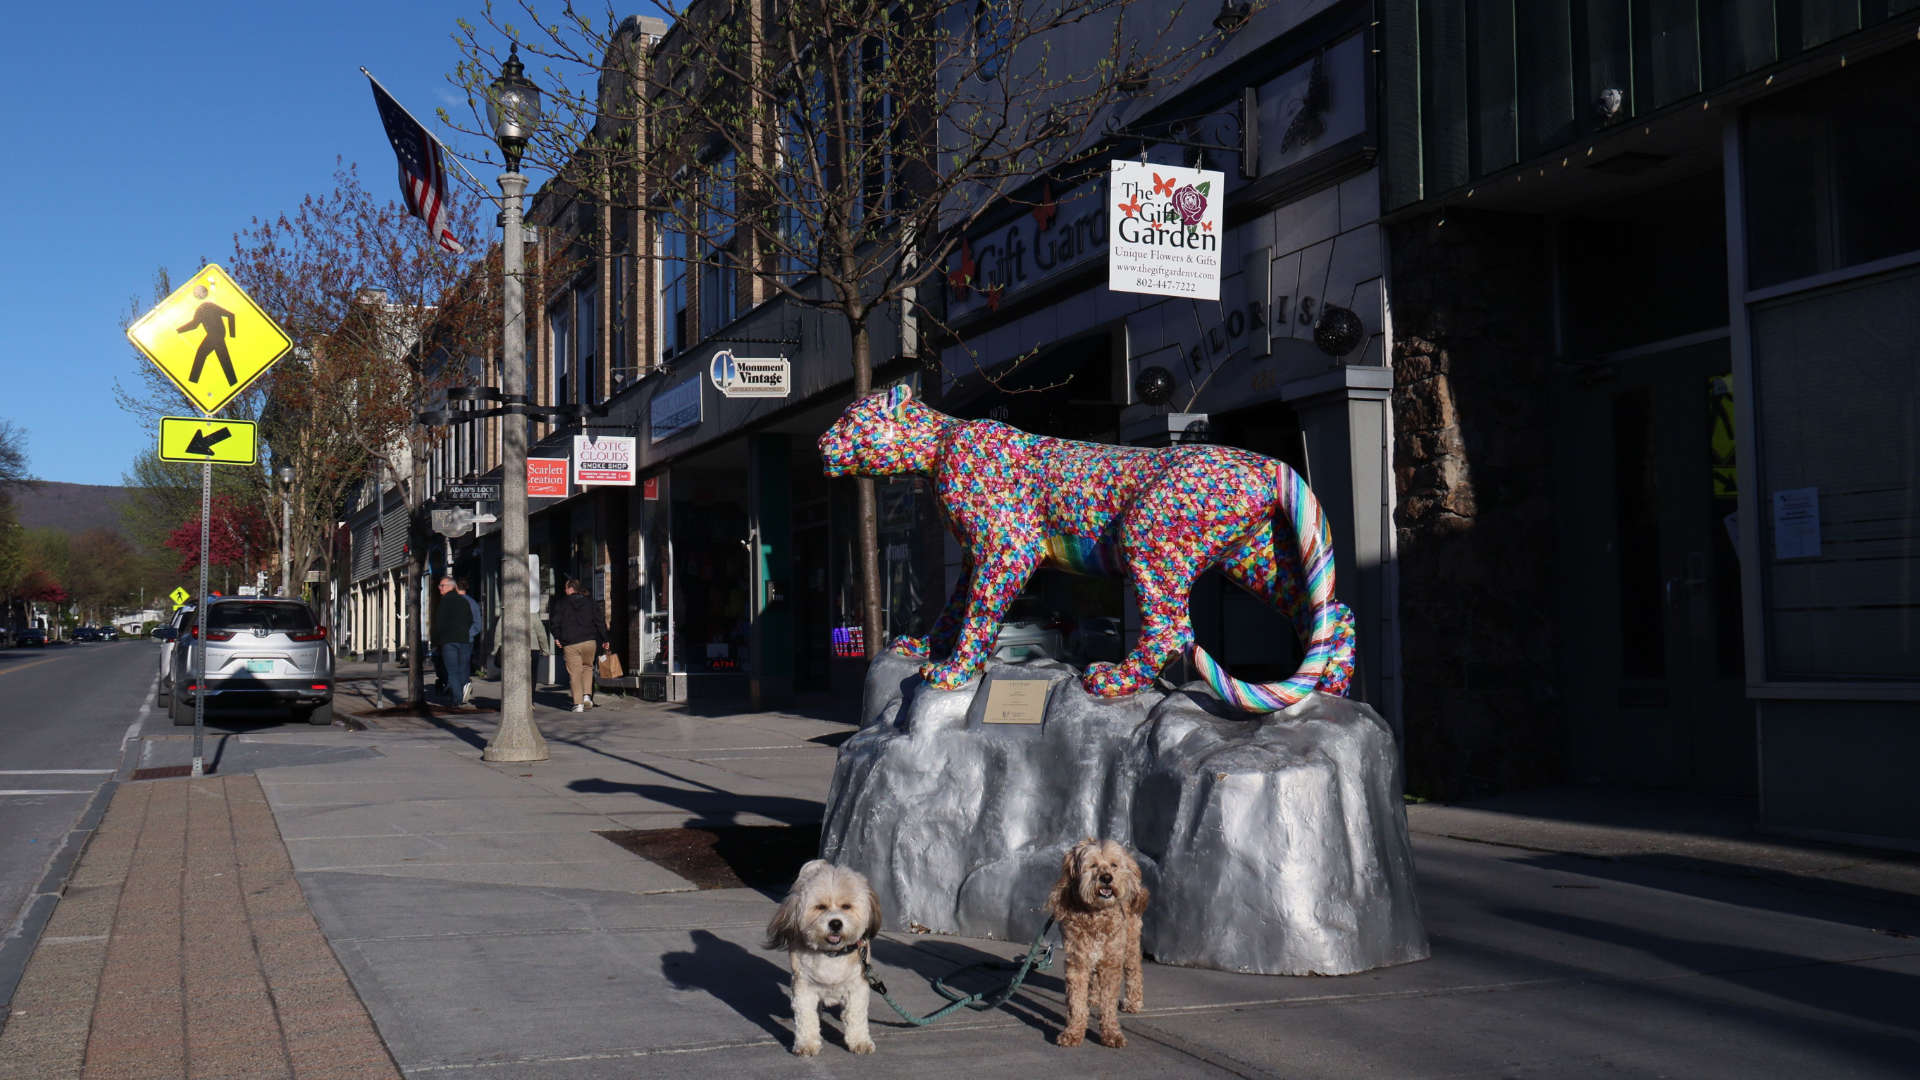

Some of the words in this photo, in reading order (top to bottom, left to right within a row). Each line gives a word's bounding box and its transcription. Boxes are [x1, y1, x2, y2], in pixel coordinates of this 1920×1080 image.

[1121, 181, 1153, 200] The
[1139, 202, 1177, 225] Gift
[974, 228, 1026, 288] Gift
[1033, 179, 1110, 269] Gard
[1118, 216, 1216, 251] Garden
[1114, 246, 1148, 261] Unique
[1150, 249, 1184, 263] Flowers
[1186, 254, 1193, 263] &
[1196, 254, 1217, 266] Gifts
[1116, 263, 1215, 280] www.thegiftgardenvt.com
[1136, 278, 1197, 292] 802-447-7222
[1190, 295, 1346, 374] FLORIS
[736, 362, 784, 371] Monument
[739, 372, 783, 386] Vintage
[583, 441, 627, 451] EXOTIC
[580, 451, 629, 462] CLOUDS
[528, 463, 563, 475] Scarlett
[528, 473, 563, 484] reation
